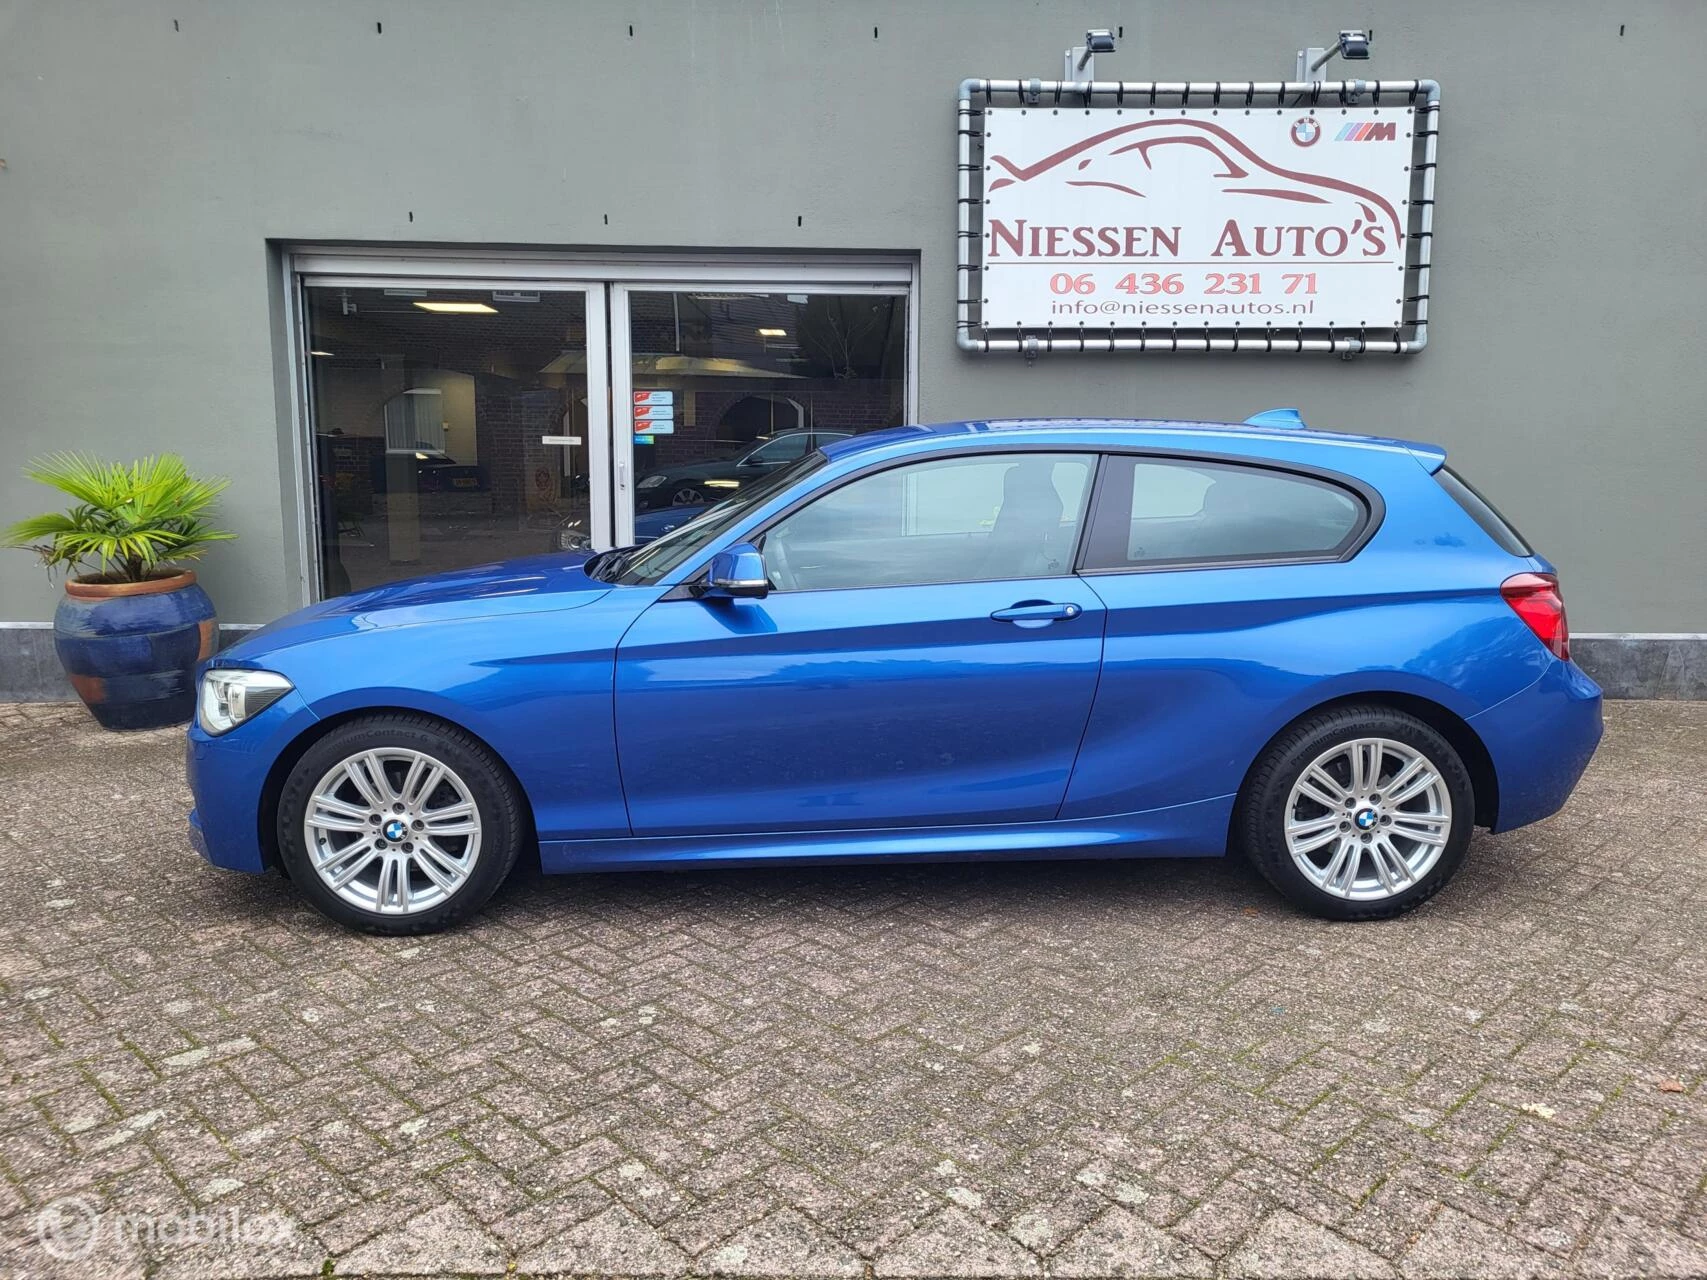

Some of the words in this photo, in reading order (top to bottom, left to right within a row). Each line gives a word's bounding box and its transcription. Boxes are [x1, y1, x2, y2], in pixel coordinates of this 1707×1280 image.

[987, 219, 1182, 257] NIESSEN
[1210, 219, 1386, 257] AUTO'S
[1050, 272, 1096, 295] 06
[1115, 272, 1185, 295] 436
[1203, 272, 1262, 295] 231
[1281, 272, 1318, 295] 71
[1052, 300, 1314, 315] info@niessenautos.nl
